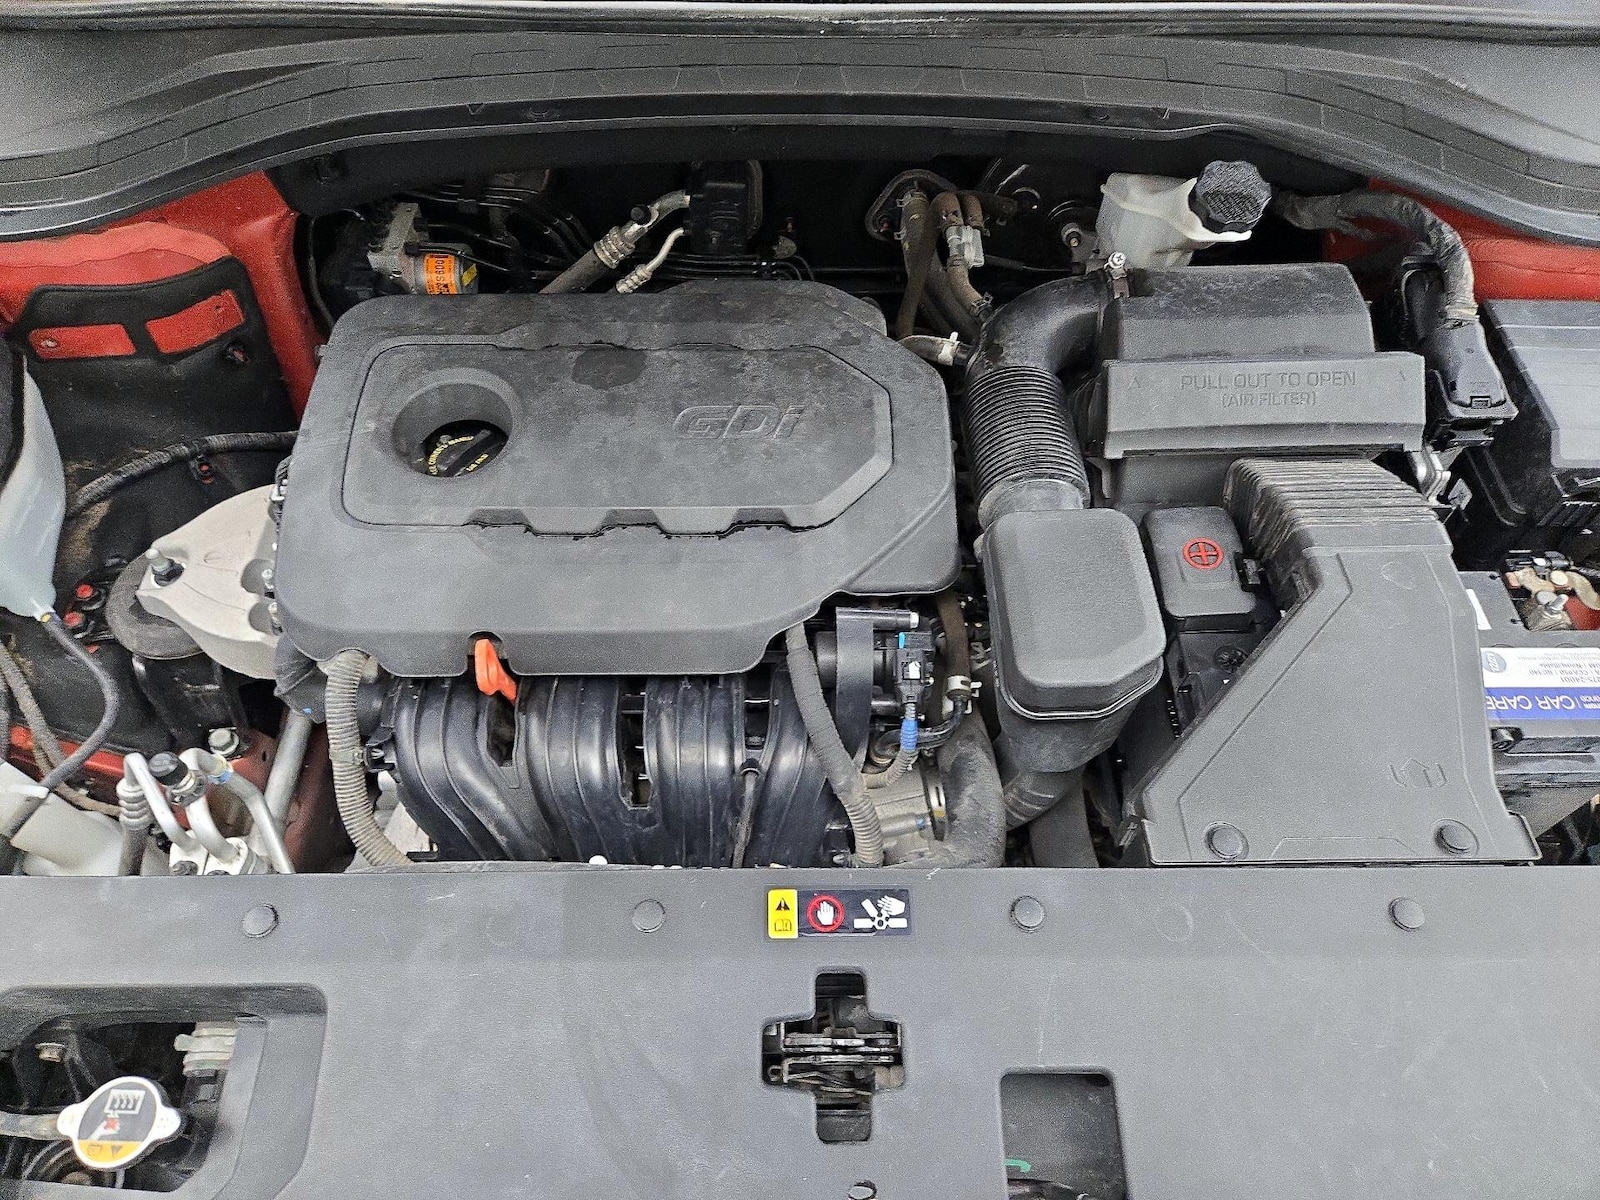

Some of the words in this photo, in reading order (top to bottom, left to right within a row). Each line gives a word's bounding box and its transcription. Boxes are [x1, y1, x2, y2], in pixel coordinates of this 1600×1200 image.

[1180, 374, 1228, 390] PULL
[1233, 373, 1271, 389] OUT
[1276, 372, 1300, 388] TO
[1306, 370, 1357, 387] OPEN
[1222, 393, 1254, 407] (AIR
[1259, 391, 1317, 406] FILTER)
[673, 404, 805, 439] GDi
[1485, 695, 1533, 710] CARE
[1535, 695, 1576, 710] CAR
